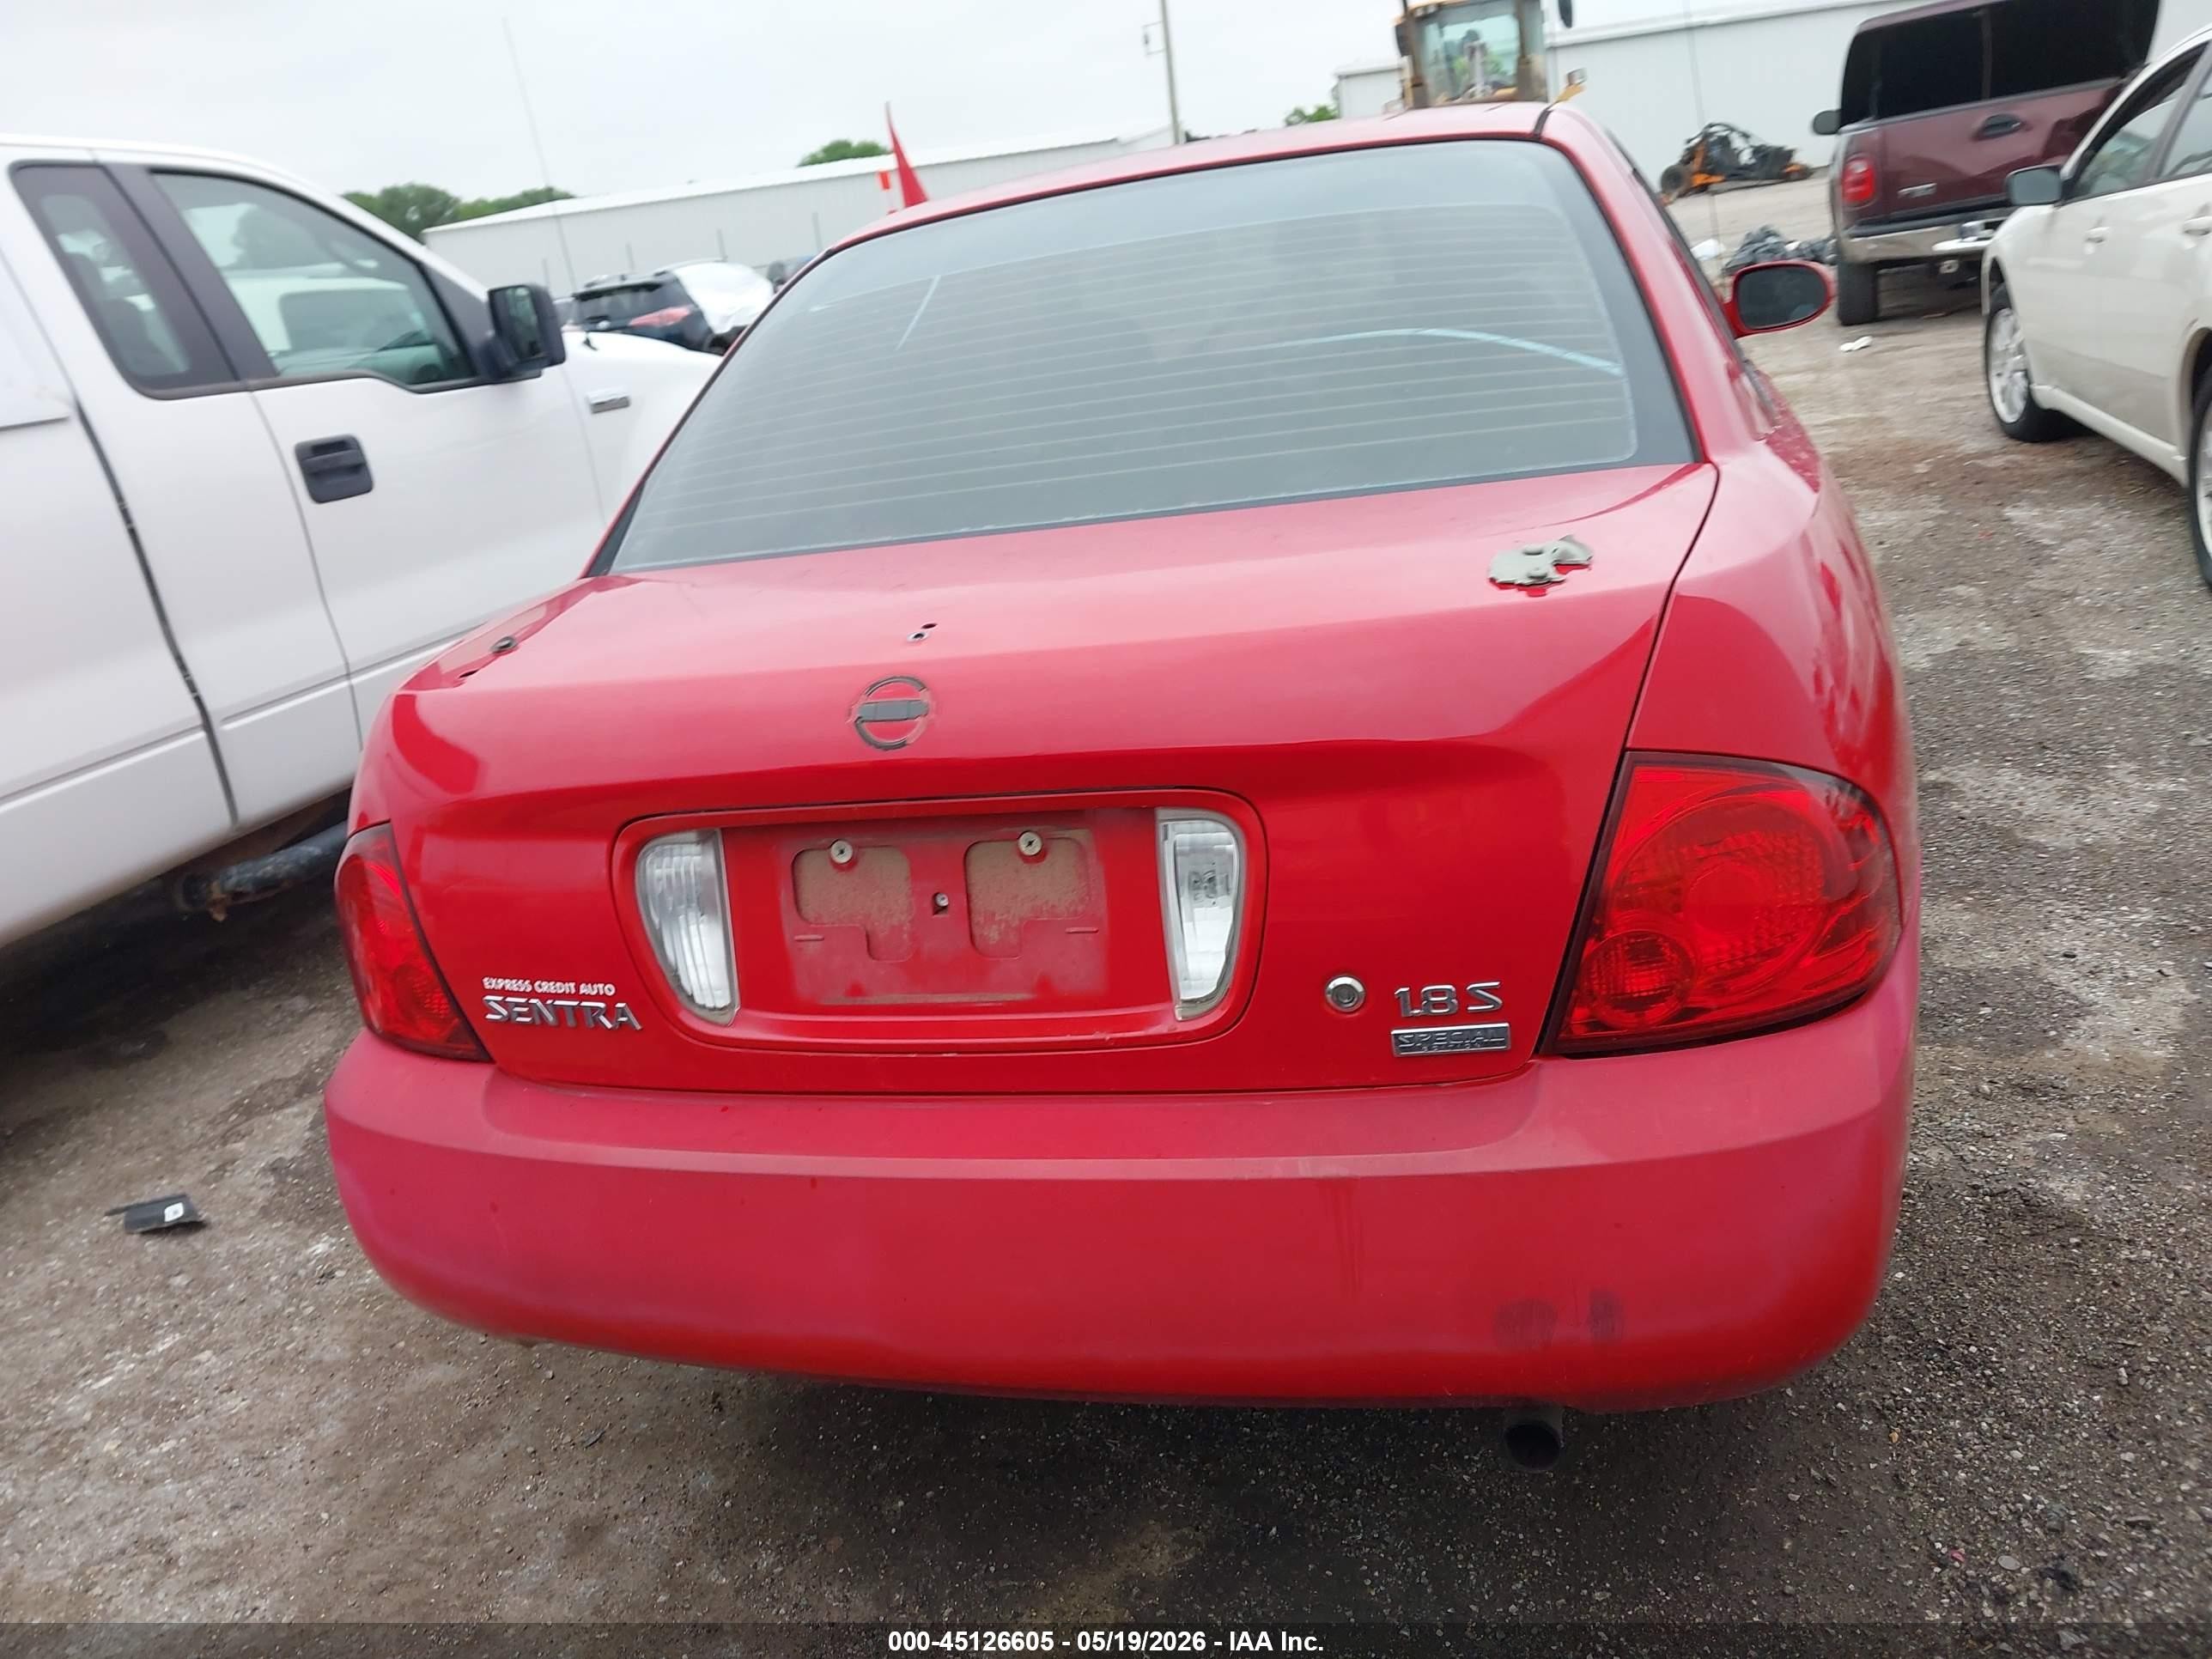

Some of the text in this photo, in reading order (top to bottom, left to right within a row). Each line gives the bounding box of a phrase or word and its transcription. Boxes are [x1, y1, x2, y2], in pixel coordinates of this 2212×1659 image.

[483, 976, 616, 996] EXPRESS CREDIT AUTO
[1466, 981, 1503, 1013] S
[483, 994, 643, 1030] SENTRA
[1398, 1030, 1505, 1048] SPECIAL
